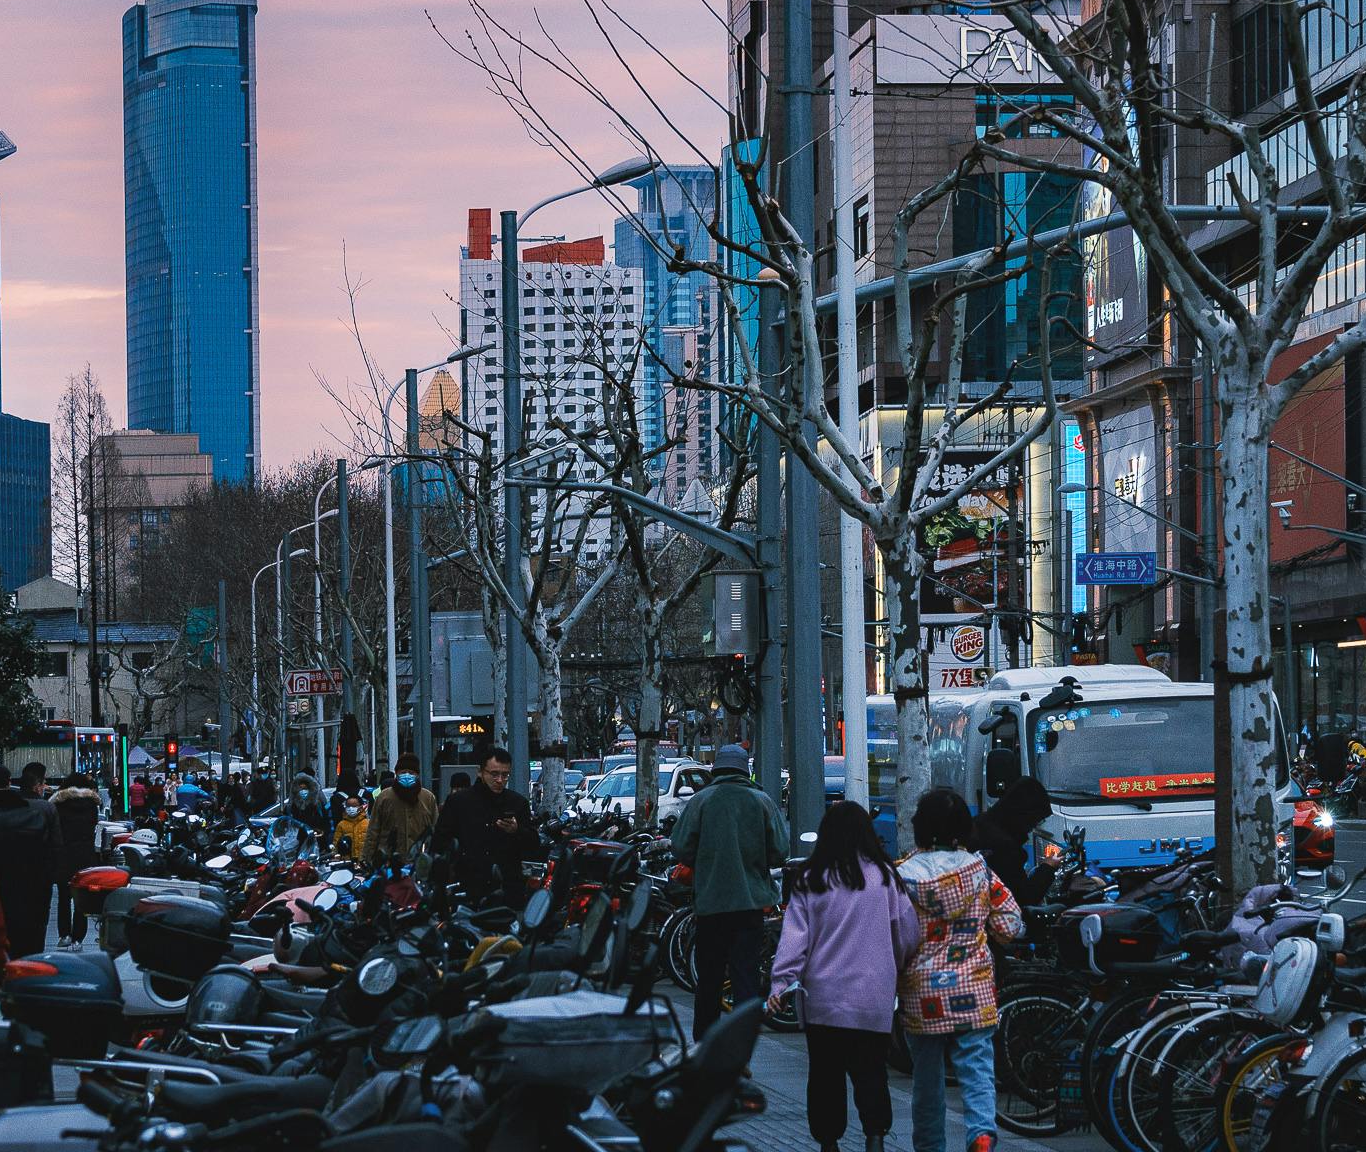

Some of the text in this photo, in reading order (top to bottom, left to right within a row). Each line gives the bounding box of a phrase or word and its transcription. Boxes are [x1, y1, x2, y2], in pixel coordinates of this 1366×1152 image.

[1093, 559, 1138, 571] 淮海中路
[953, 631, 982, 646] BURGER
[954, 638, 984, 656] KING
[1105, 780, 1158, 794] 比学赶超
[1138, 836, 1204, 855] JMC
